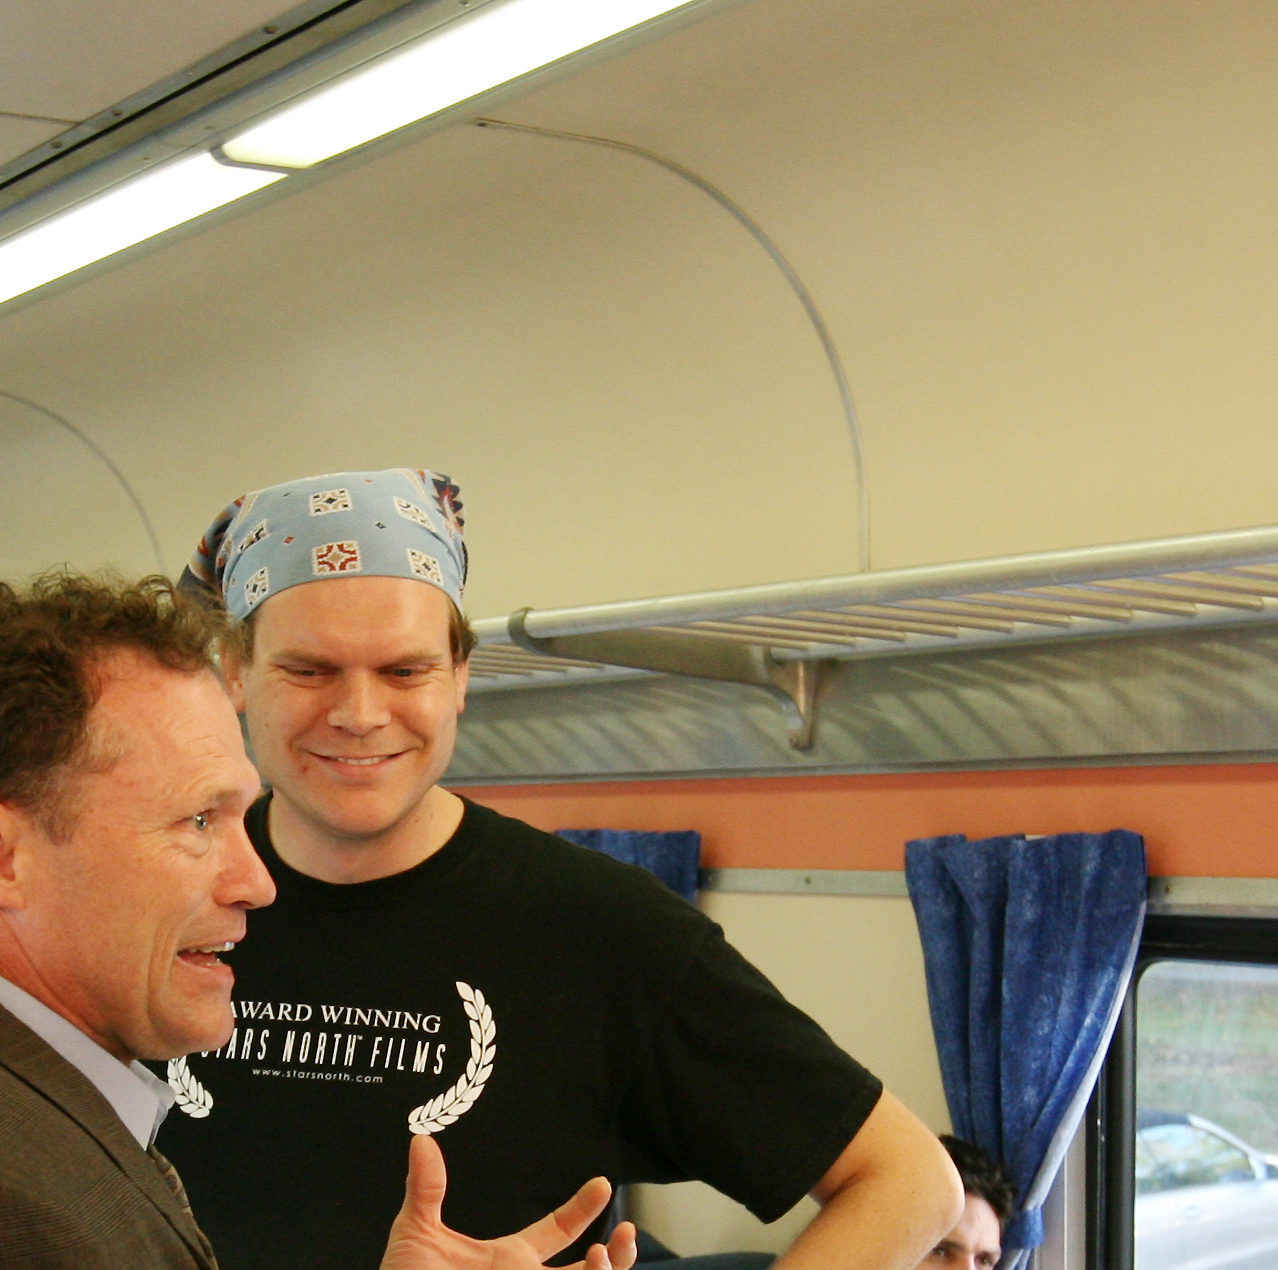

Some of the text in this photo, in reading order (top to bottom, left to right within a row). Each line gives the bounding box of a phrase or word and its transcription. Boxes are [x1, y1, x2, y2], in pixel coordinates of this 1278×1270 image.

[321, 1005, 441, 1033] WINNING
[201, 1028, 270, 1060] ARS
[370, 1036, 446, 1075] FILMS
[251, 1067, 383, 1083] www.starsnorth.com
